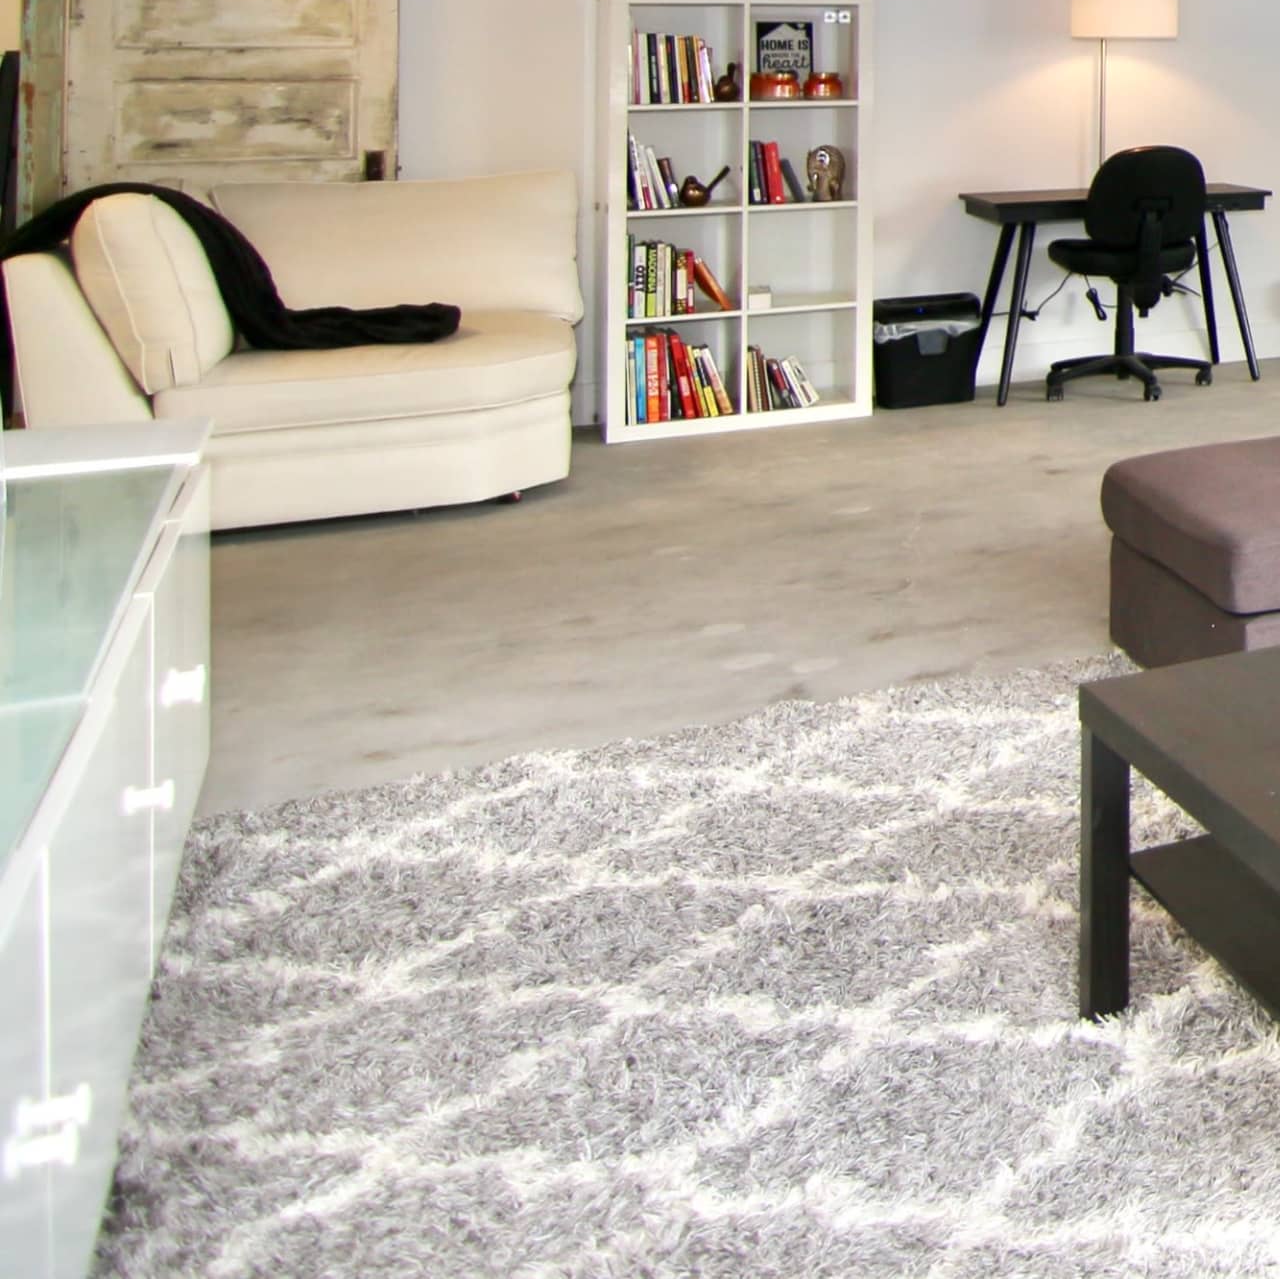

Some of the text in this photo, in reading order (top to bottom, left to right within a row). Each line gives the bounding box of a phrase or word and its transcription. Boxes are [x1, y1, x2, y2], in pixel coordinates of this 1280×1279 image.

[760, 39, 809, 51] HOME IS
[763, 53, 809, 70] heart
[647, 248, 657, 293] MADONNA
